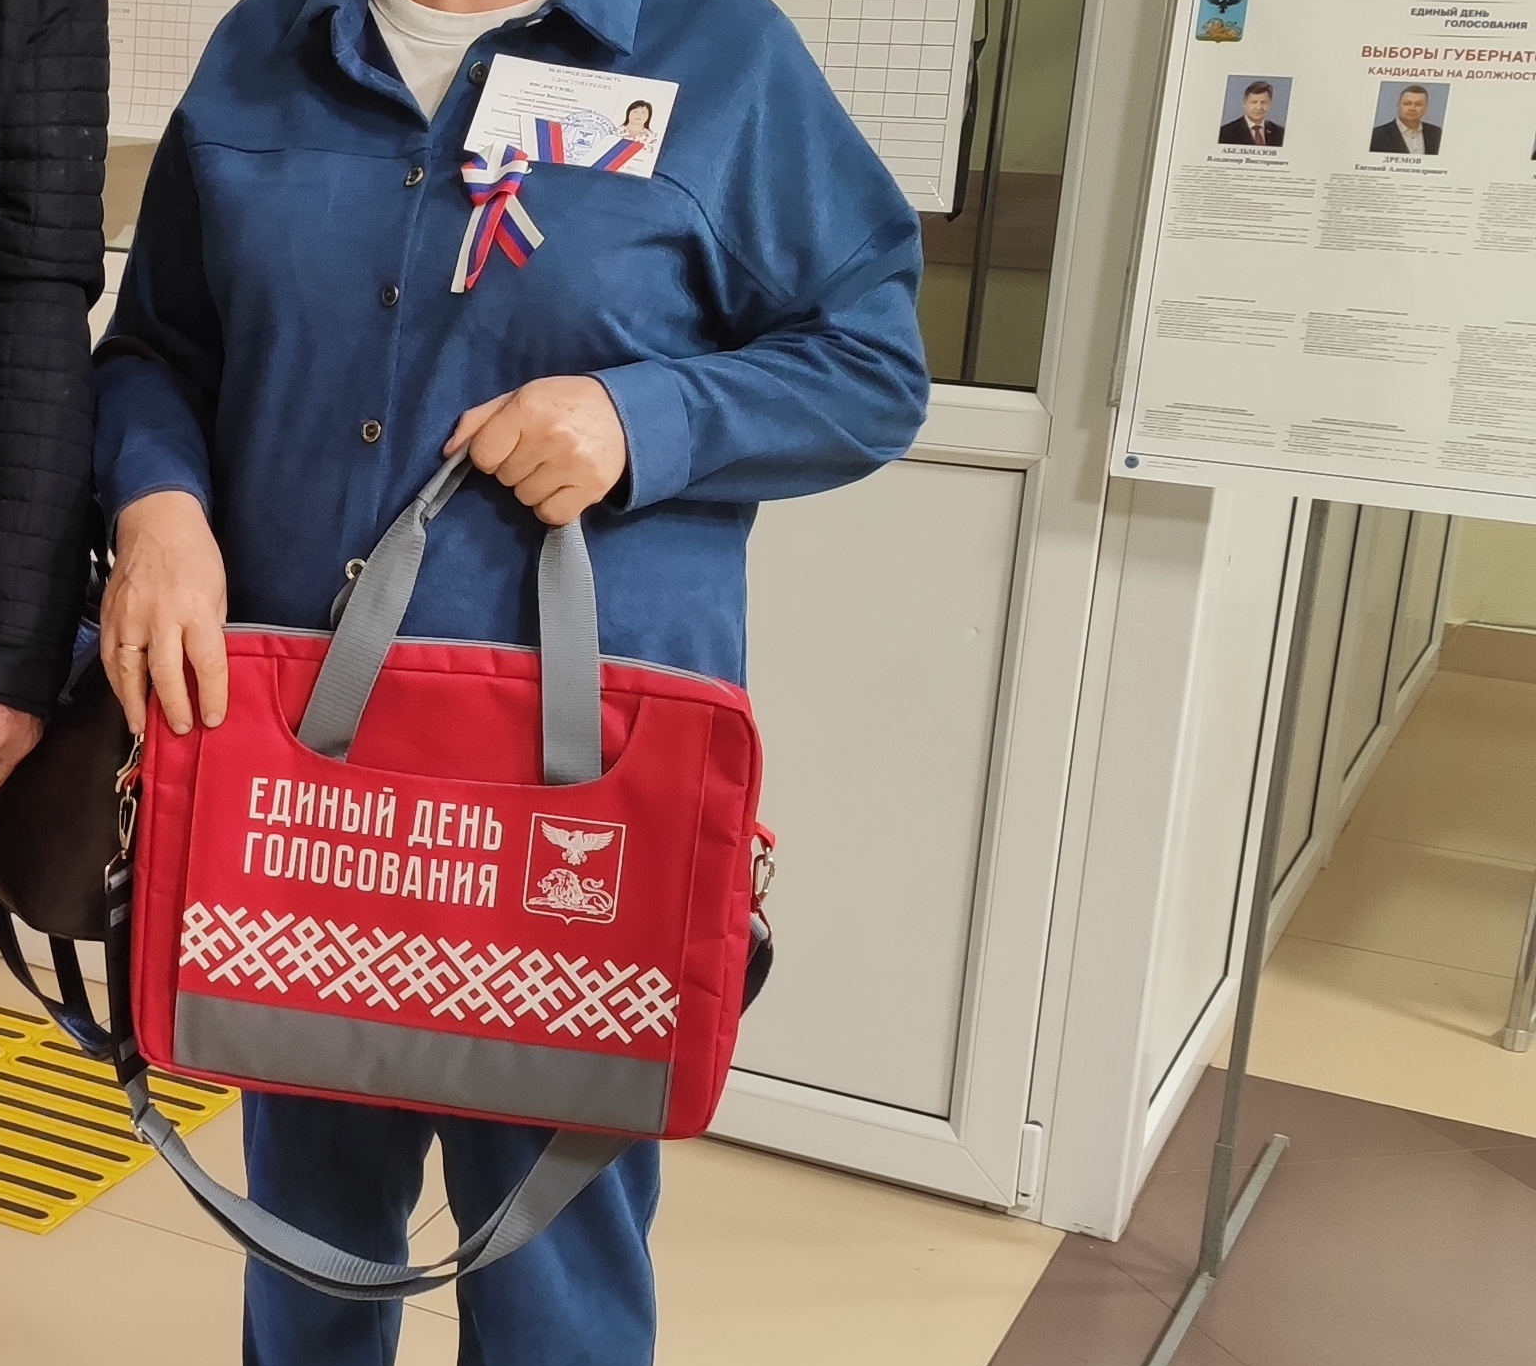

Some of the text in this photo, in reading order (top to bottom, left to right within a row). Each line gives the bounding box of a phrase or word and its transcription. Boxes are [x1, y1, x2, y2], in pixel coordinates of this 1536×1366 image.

[1410, 7, 1490, 18] ЕДИНЫЙ ДЕНЬ
[1444, 19, 1528, 30] ГОЛОСОВАНИЯ
[1361, 45, 1536, 63] ВЫБОРЫ ГУБЕРНАТ
[1367, 66, 1444, 78] КАНДИДАТЫ
[1446, 69, 1464, 79] НА
[1382, 156, 1422, 165] ДРЕМОВ
[248, 776, 503, 852] ЕДИНЫЙ ДЕНЬ
[243, 831, 499, 909] ГОЛОСОВАНИЯ
